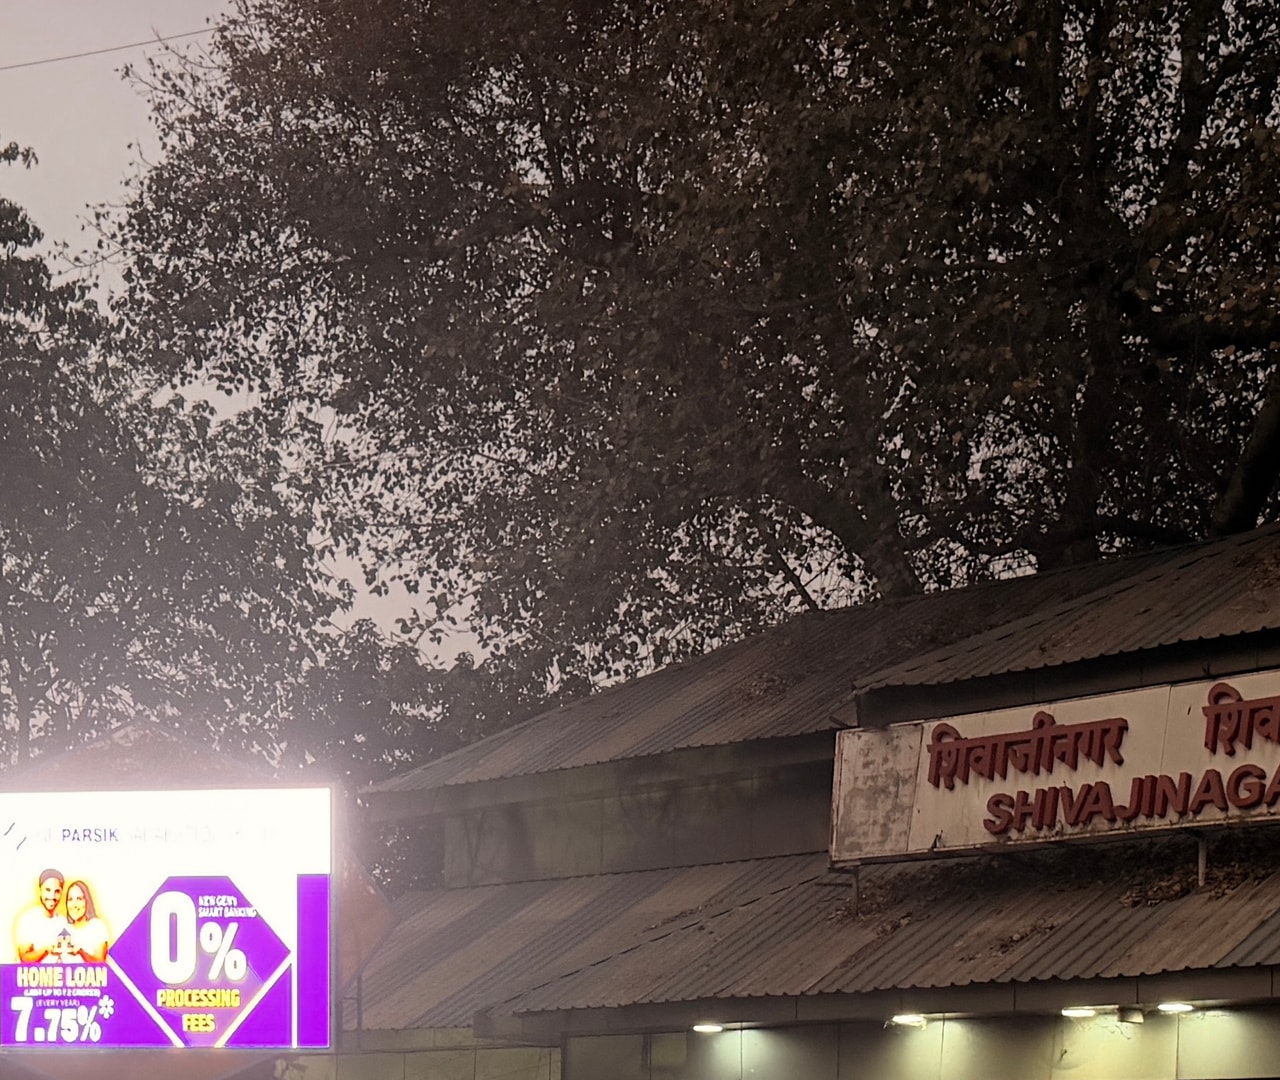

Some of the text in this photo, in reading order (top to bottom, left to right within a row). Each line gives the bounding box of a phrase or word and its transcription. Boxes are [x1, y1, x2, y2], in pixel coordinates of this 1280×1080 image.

[925, 709, 1129, 789] शिवाजीनगर
[61, 828, 119, 843] PARSIK
[150, 890, 248, 984] 0%
[16, 966, 108, 987] HOME LOAN
[156, 988, 241, 1008] PROCESSING
[182, 1014, 216, 1032] FEES
